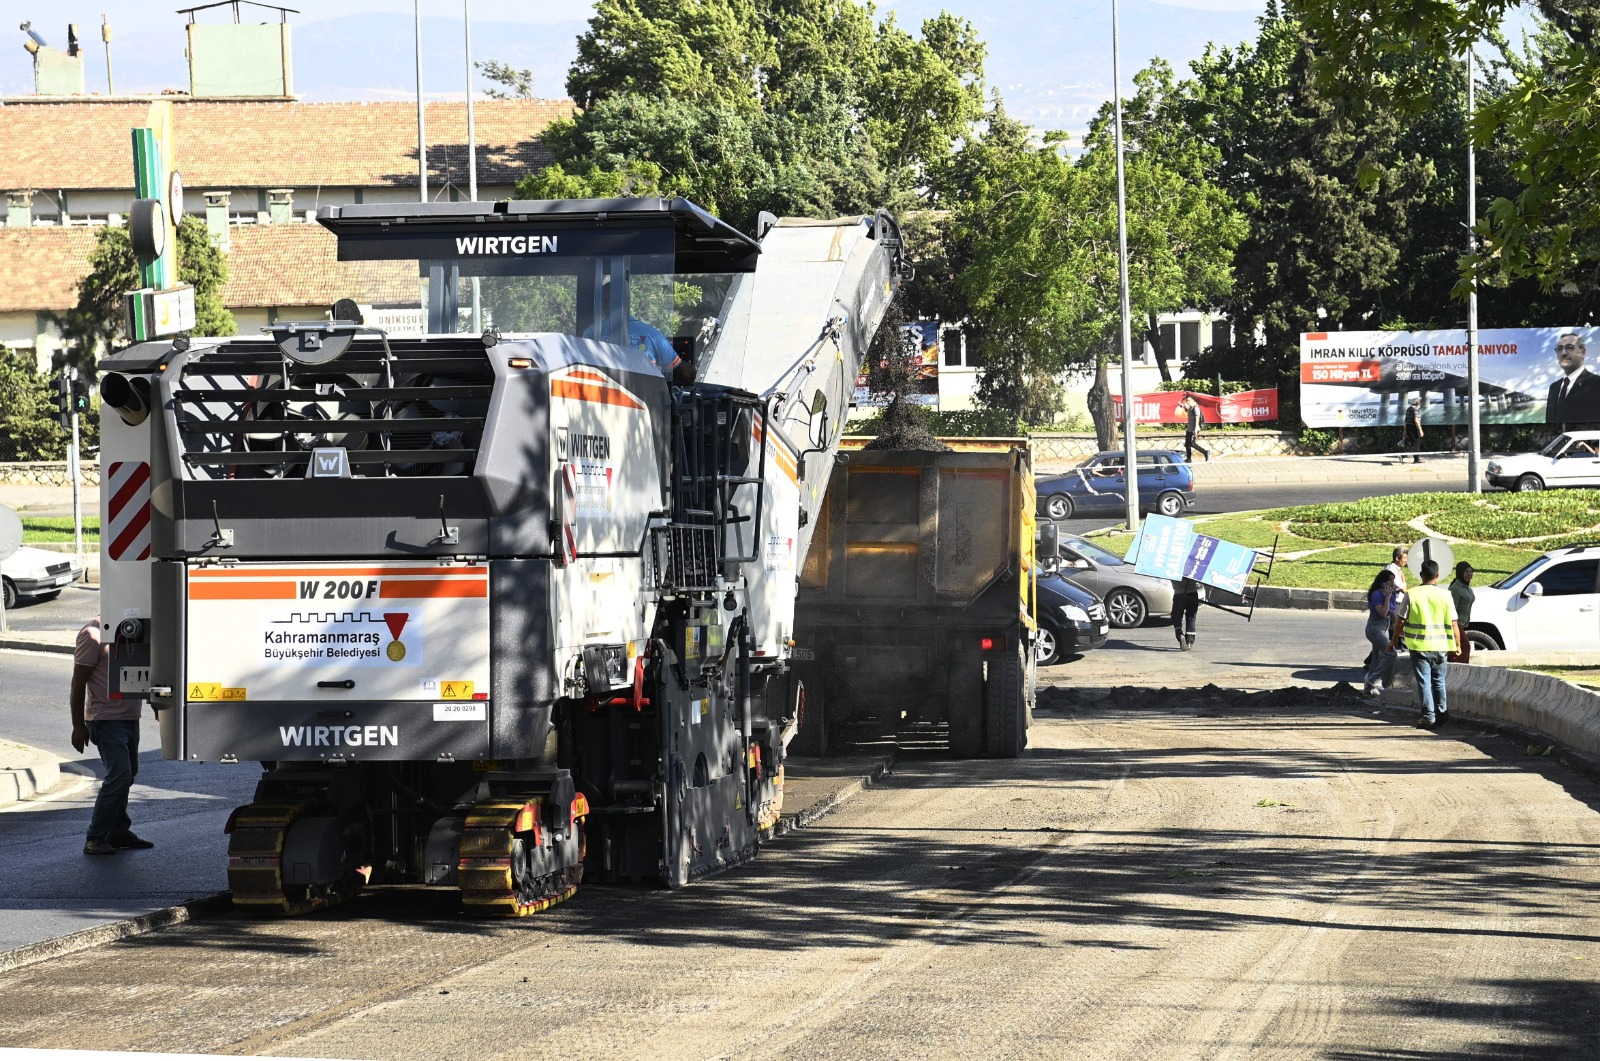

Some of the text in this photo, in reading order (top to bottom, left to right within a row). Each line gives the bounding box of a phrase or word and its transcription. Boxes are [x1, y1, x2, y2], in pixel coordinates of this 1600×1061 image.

[456, 236, 557, 254] WIRTGEN
[1310, 344, 1517, 359] İMRAN KILIÇ KÖPRÜSÜ TAMAMANIYOR
[1312, 369, 1372, 380] 150 Milyon TL
[571, 434, 610, 459] WIRTGEN
[300, 581, 320, 599] W
[264, 631, 380, 645] Kahramanmaraş
[264, 647, 381, 660] Büyükşehir Belediyesi
[279, 725, 398, 747] WIRTGEN
